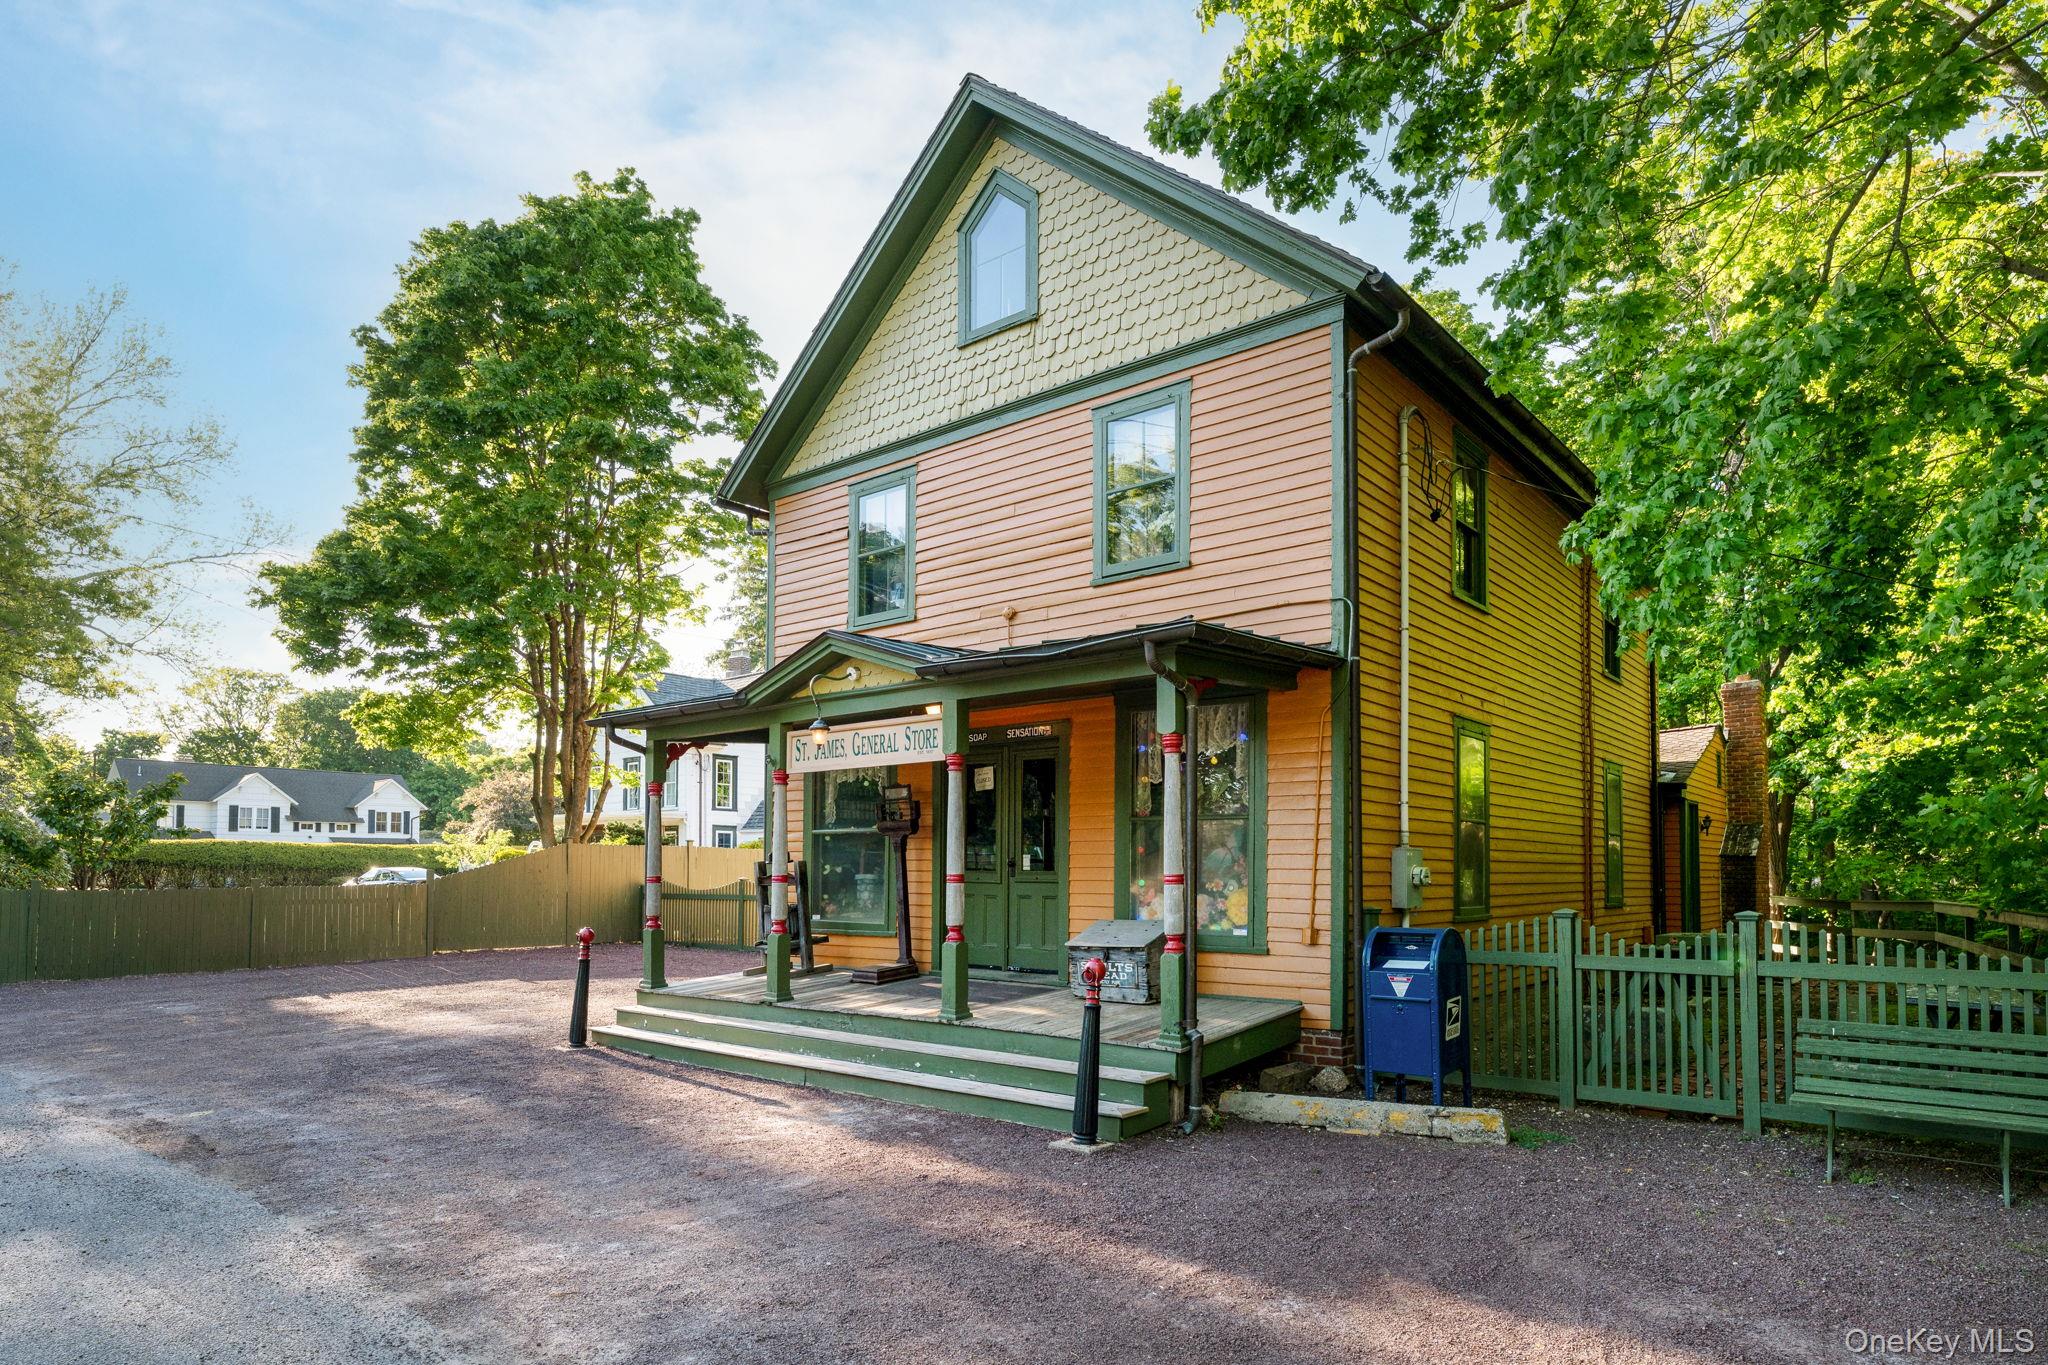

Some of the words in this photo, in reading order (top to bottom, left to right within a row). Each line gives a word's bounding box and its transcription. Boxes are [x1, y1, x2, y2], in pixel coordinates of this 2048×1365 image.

[795, 738, 810, 762] ST.
[814, 736, 847, 761] JAMES,
[852, 732, 899, 756] GENERAL
[904, 726, 939, 751] STORE
[968, 733, 988, 742] SOAP
